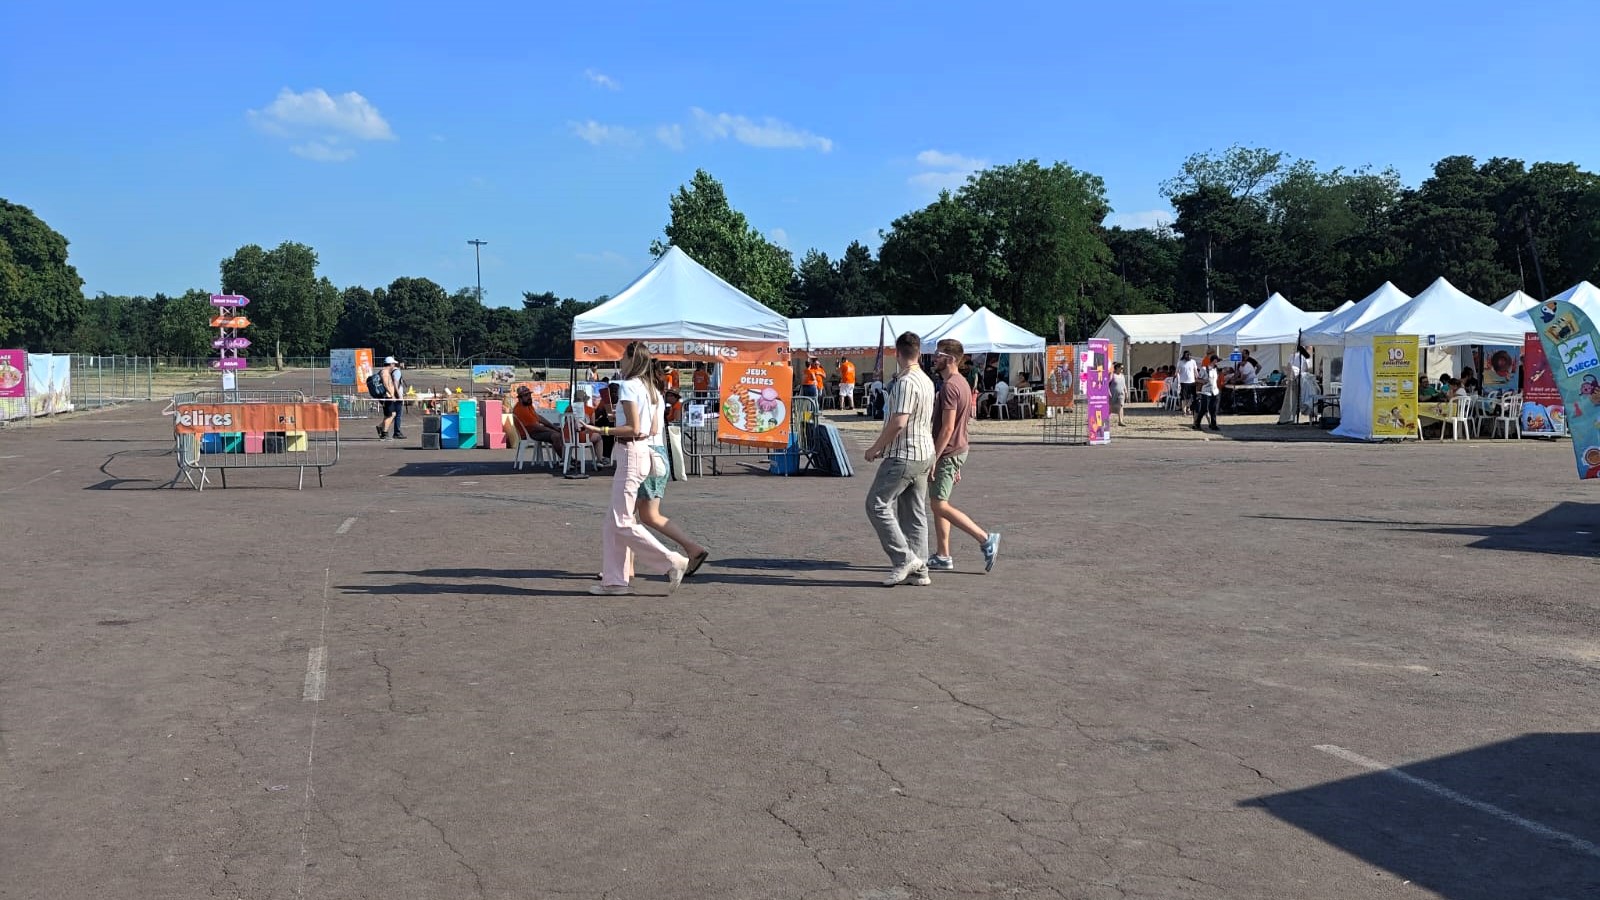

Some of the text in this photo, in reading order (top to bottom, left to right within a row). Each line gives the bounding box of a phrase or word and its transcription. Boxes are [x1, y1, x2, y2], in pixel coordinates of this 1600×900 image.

[683, 341, 738, 358] Délires
[1388, 347, 1404, 360] 10
[745, 367, 767, 376] JEUX
[1567, 358, 1598, 375] DJECO
